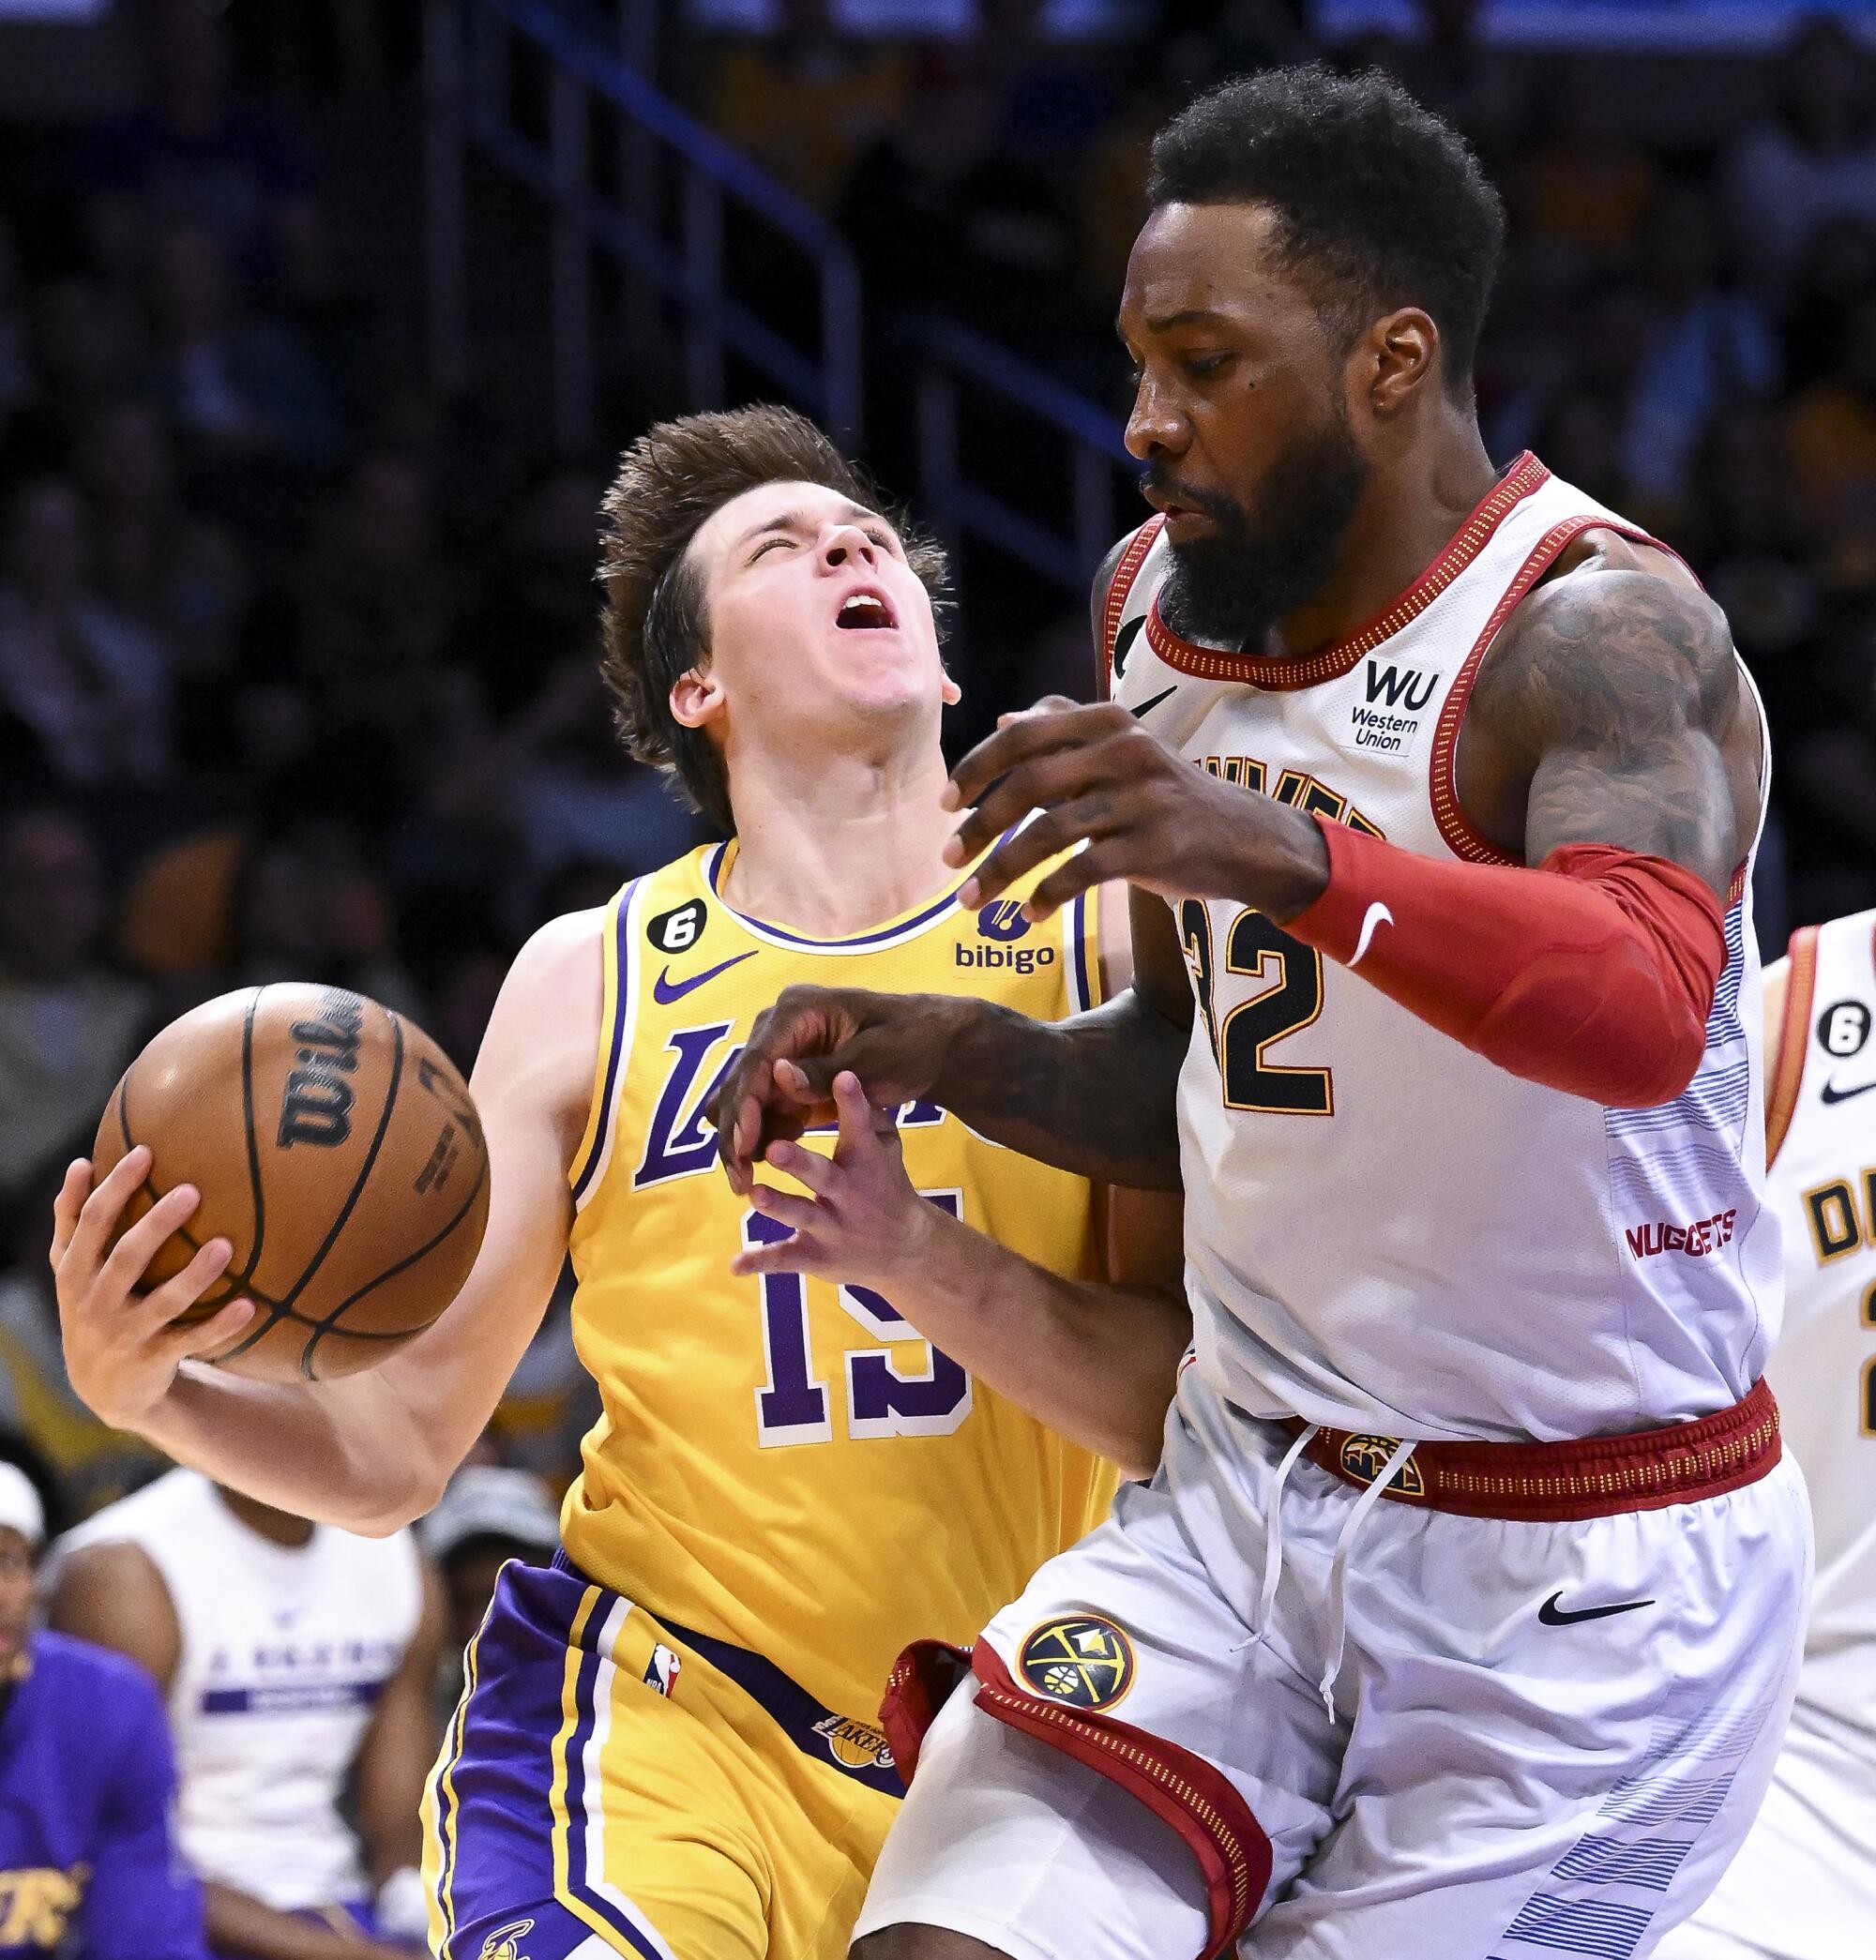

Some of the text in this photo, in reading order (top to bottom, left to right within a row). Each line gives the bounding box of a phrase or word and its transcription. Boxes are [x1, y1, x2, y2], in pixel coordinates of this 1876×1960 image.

[1366, 659, 1440, 711] WU
[1352, 706, 1418, 733] Western
[1355, 728, 1401, 751] Union
[662, 907, 697, 948] 6
[955, 942, 1054, 974] bibigo
[1828, 1006, 1865, 1054] 6
[1625, 1208, 1737, 1261] NUGGETS
